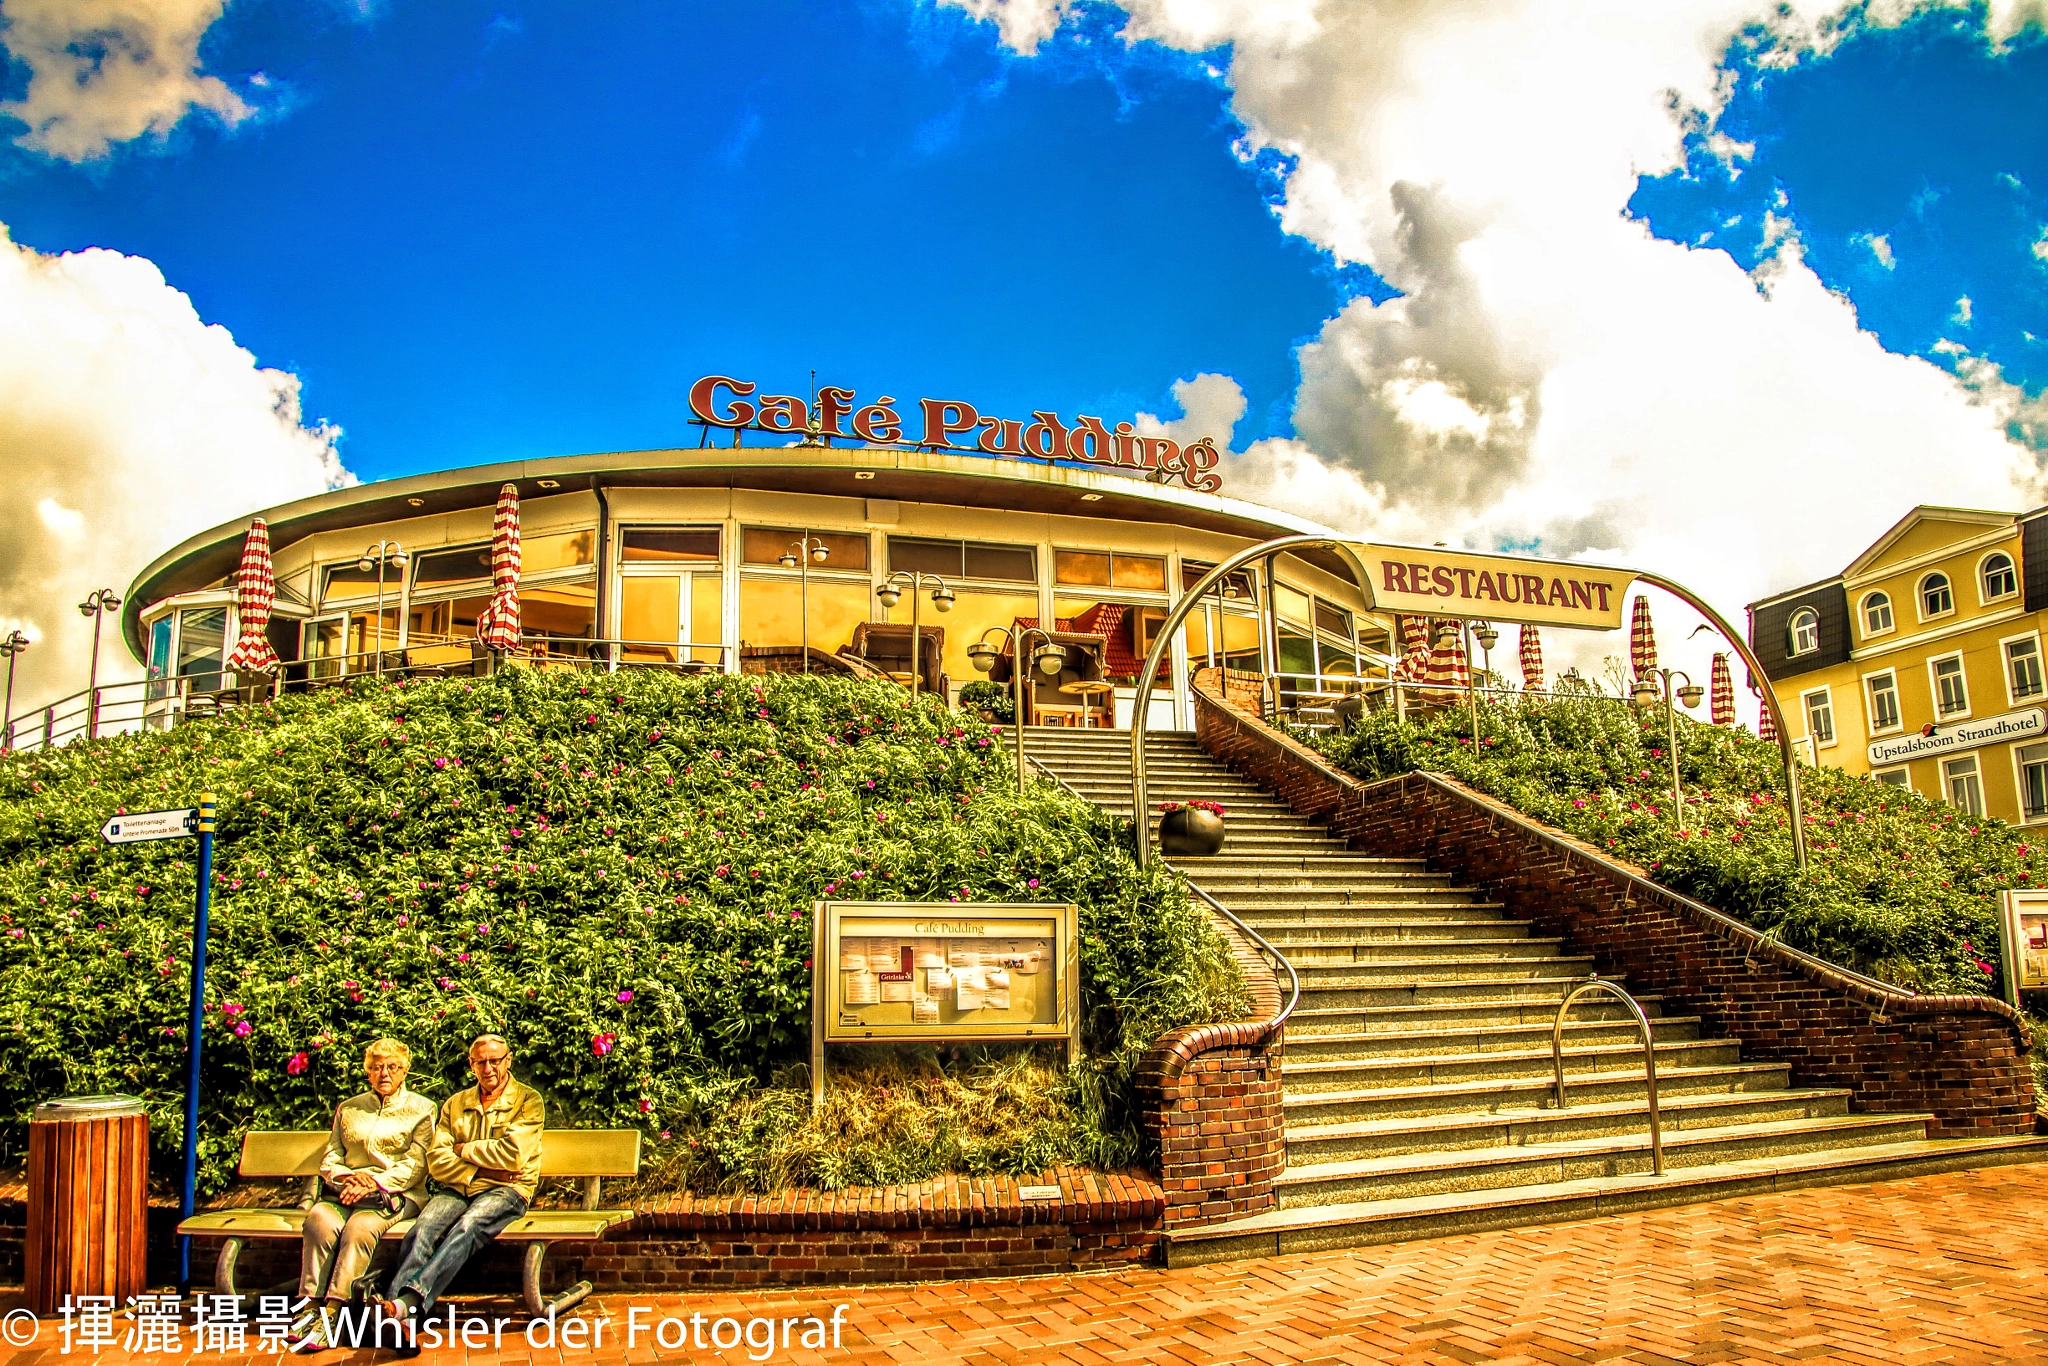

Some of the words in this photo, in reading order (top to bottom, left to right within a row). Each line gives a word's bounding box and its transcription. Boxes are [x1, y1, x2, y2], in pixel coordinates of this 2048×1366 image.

[688, 375, 902, 445] Café
[919, 398, 1224, 494] Pudding
[1380, 560, 1613, 612] RESTAURANT
[1872, 737, 1954, 760] Upstalsboom
[1957, 714, 2039, 743] Strandhotel
[123, 819, 167, 828] Toilettenanlage
[914, 922, 939, 934] Café
[941, 922, 985, 936] Pudding
